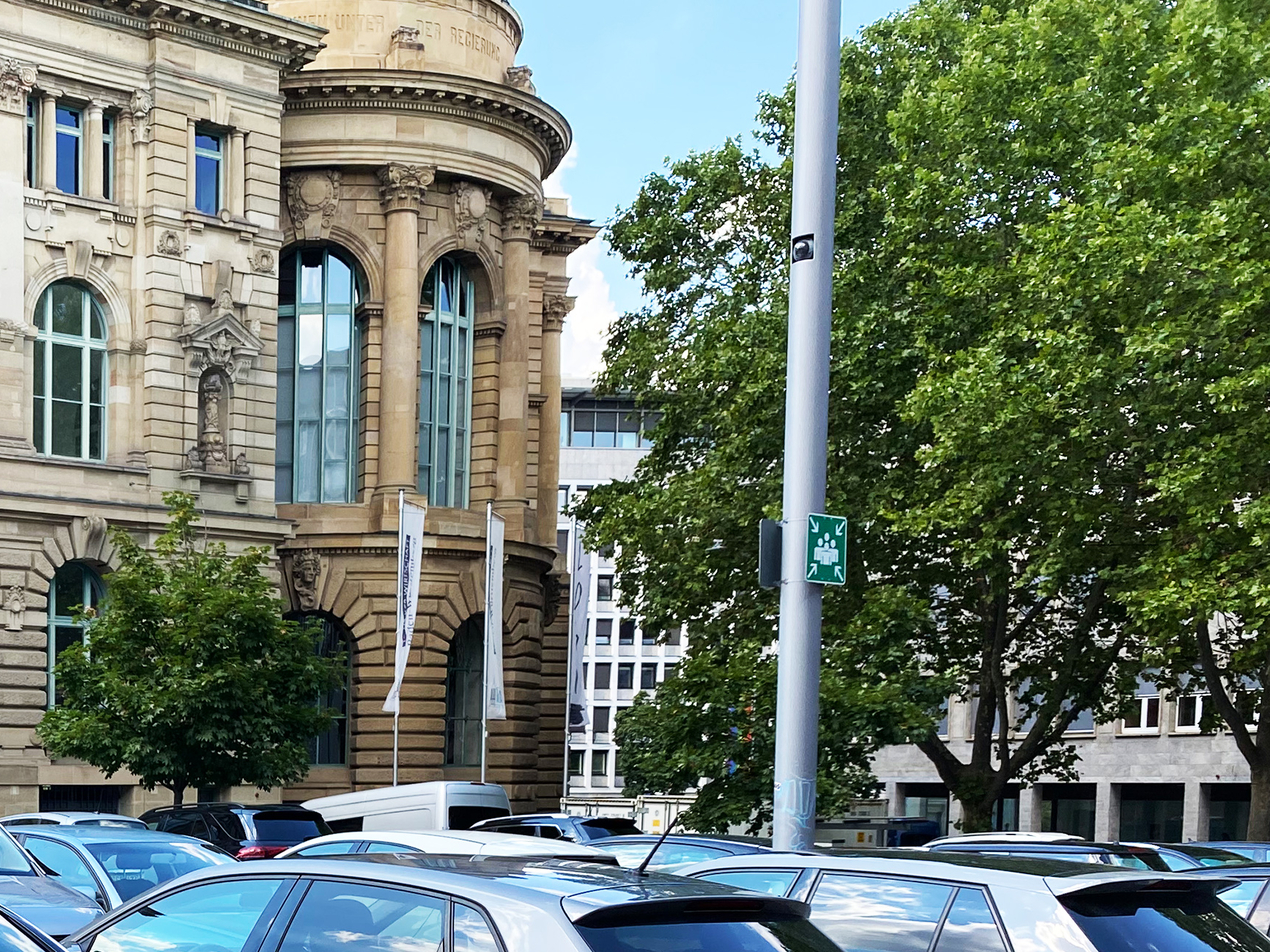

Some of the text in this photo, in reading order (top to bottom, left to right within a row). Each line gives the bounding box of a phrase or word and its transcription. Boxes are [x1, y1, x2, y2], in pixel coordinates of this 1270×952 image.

[335, 14, 385, 33] UNTER
[415, 19, 441, 40] DER
[450, 26, 501, 63] REGIERUNG
